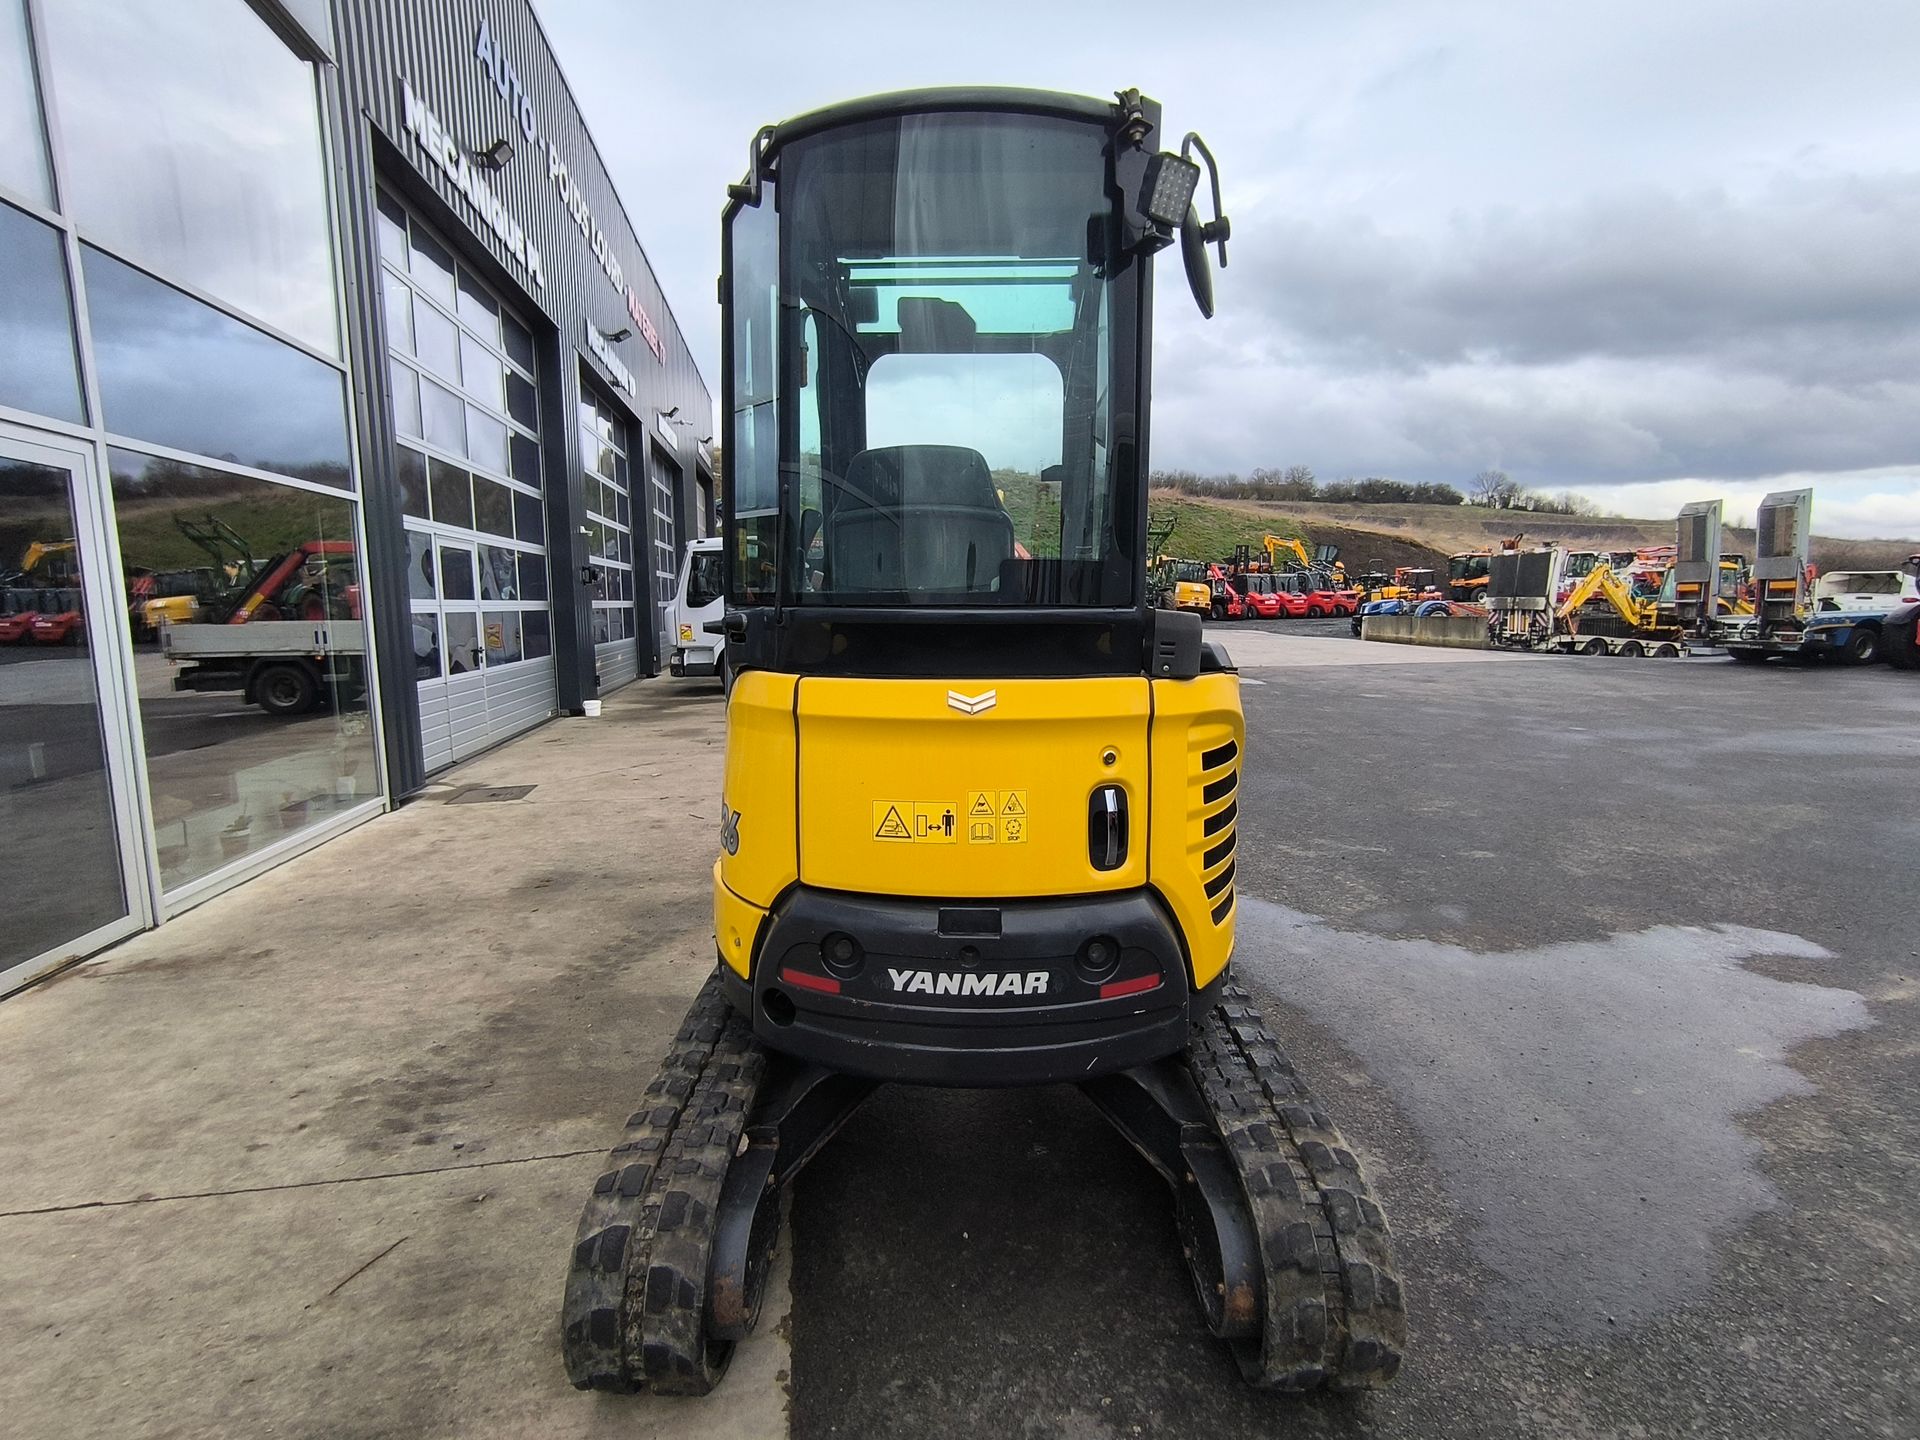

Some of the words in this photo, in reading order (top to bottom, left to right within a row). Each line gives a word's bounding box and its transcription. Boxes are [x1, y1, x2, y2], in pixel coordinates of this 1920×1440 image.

[402, 79, 525, 269] MECANIQUE
[525, 238, 544, 289] PL
[476, 19, 534, 144] AUTO
[547, 142, 589, 242] POIDS
[589, 216, 623, 295] LOURD
[887, 968, 1050, 996] YANMAR
